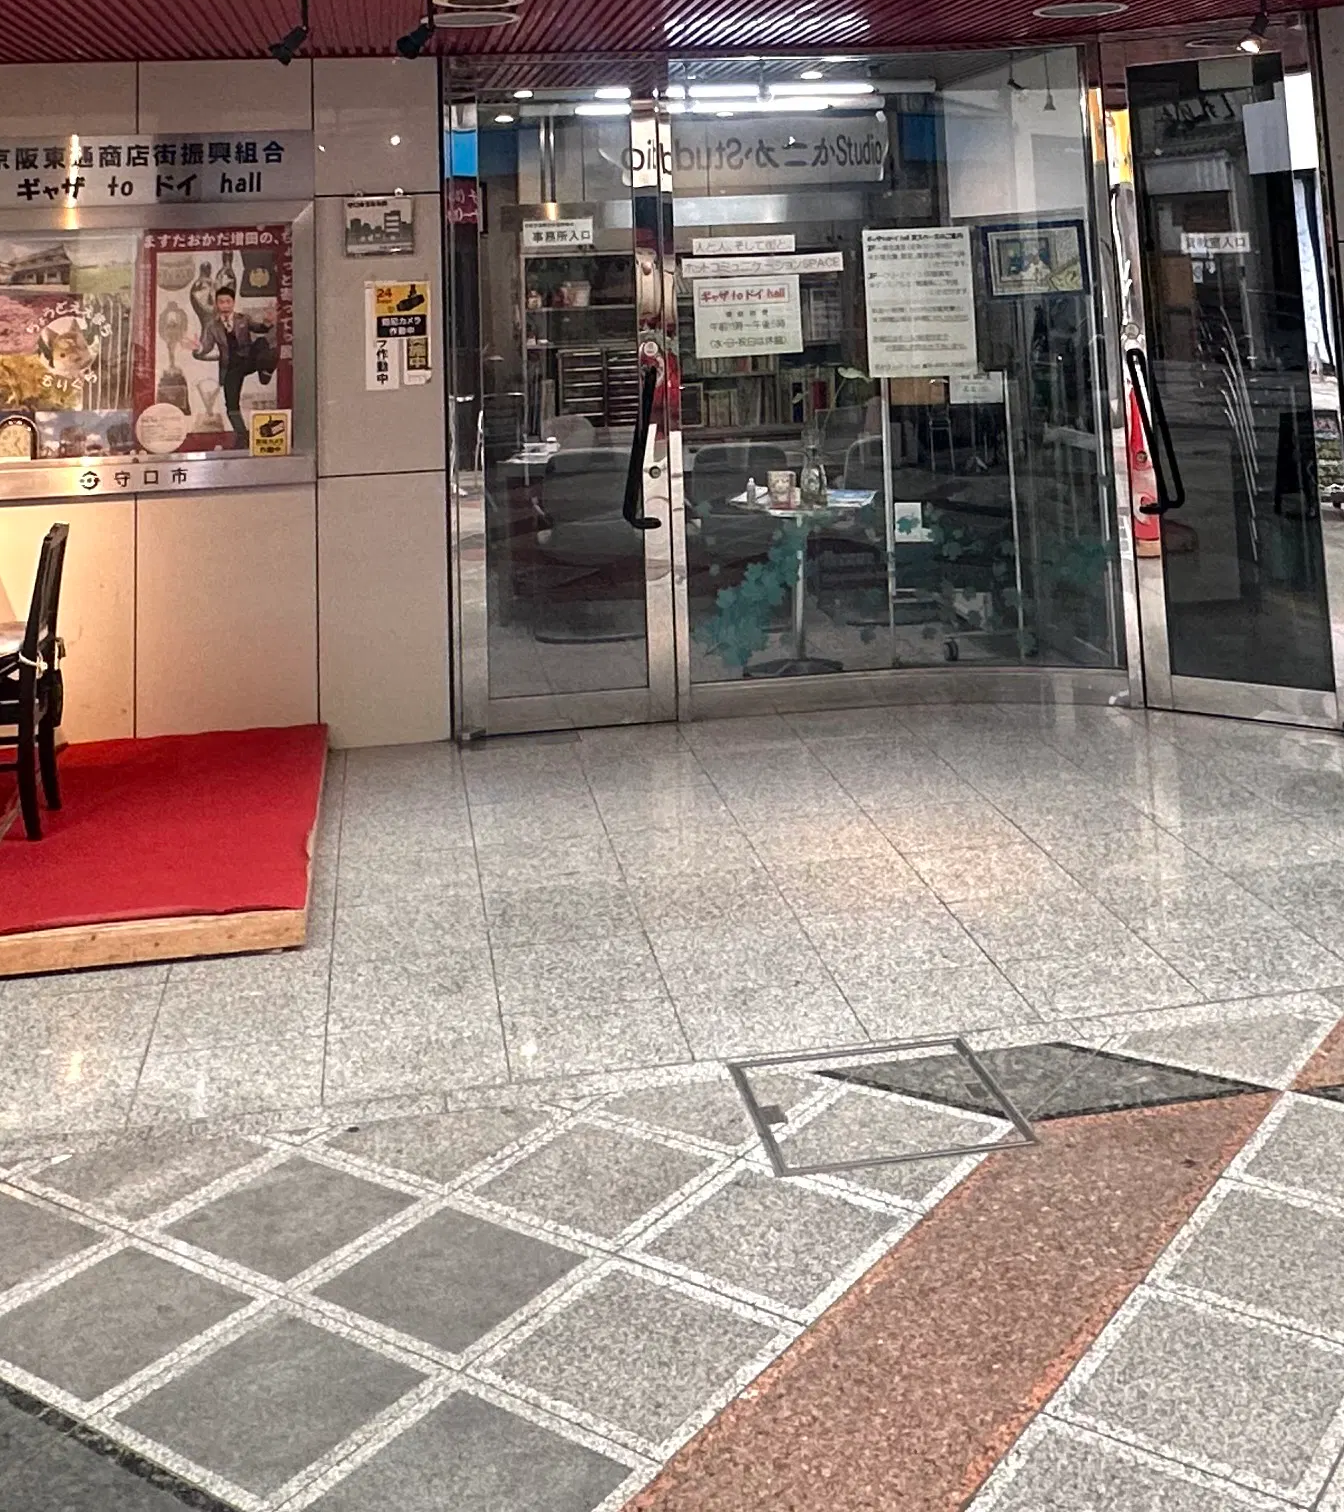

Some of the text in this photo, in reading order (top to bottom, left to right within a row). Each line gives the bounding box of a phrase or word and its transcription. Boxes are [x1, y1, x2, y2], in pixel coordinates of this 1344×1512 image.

[17, 171, 262, 201] ギャザ to ドイ hall
[376, 289, 393, 299] 24
[114, 467, 189, 488] 守口市
